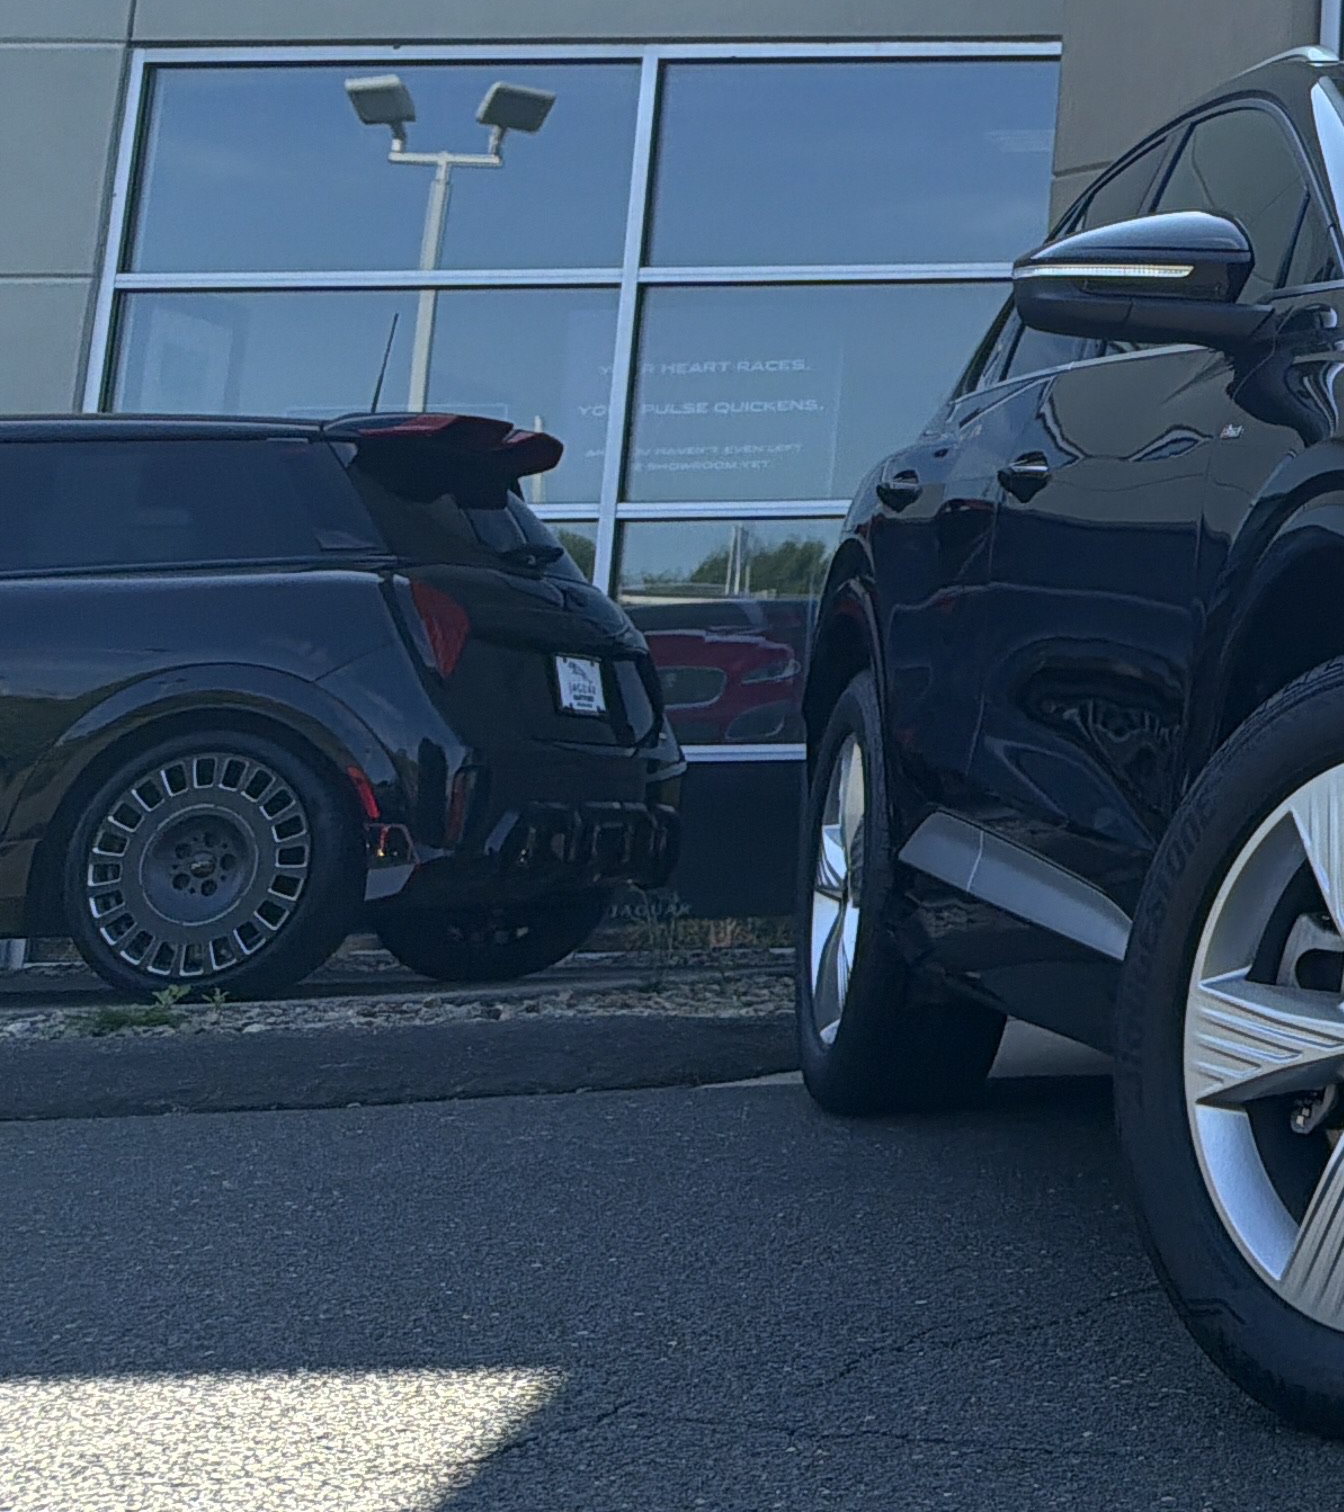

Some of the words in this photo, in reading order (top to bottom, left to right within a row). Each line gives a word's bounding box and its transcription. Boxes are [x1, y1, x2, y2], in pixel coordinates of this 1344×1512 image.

[661, 361, 732, 374] HEART
[737, 358, 811, 372] RACES.
[641, 401, 708, 414] PULSE
